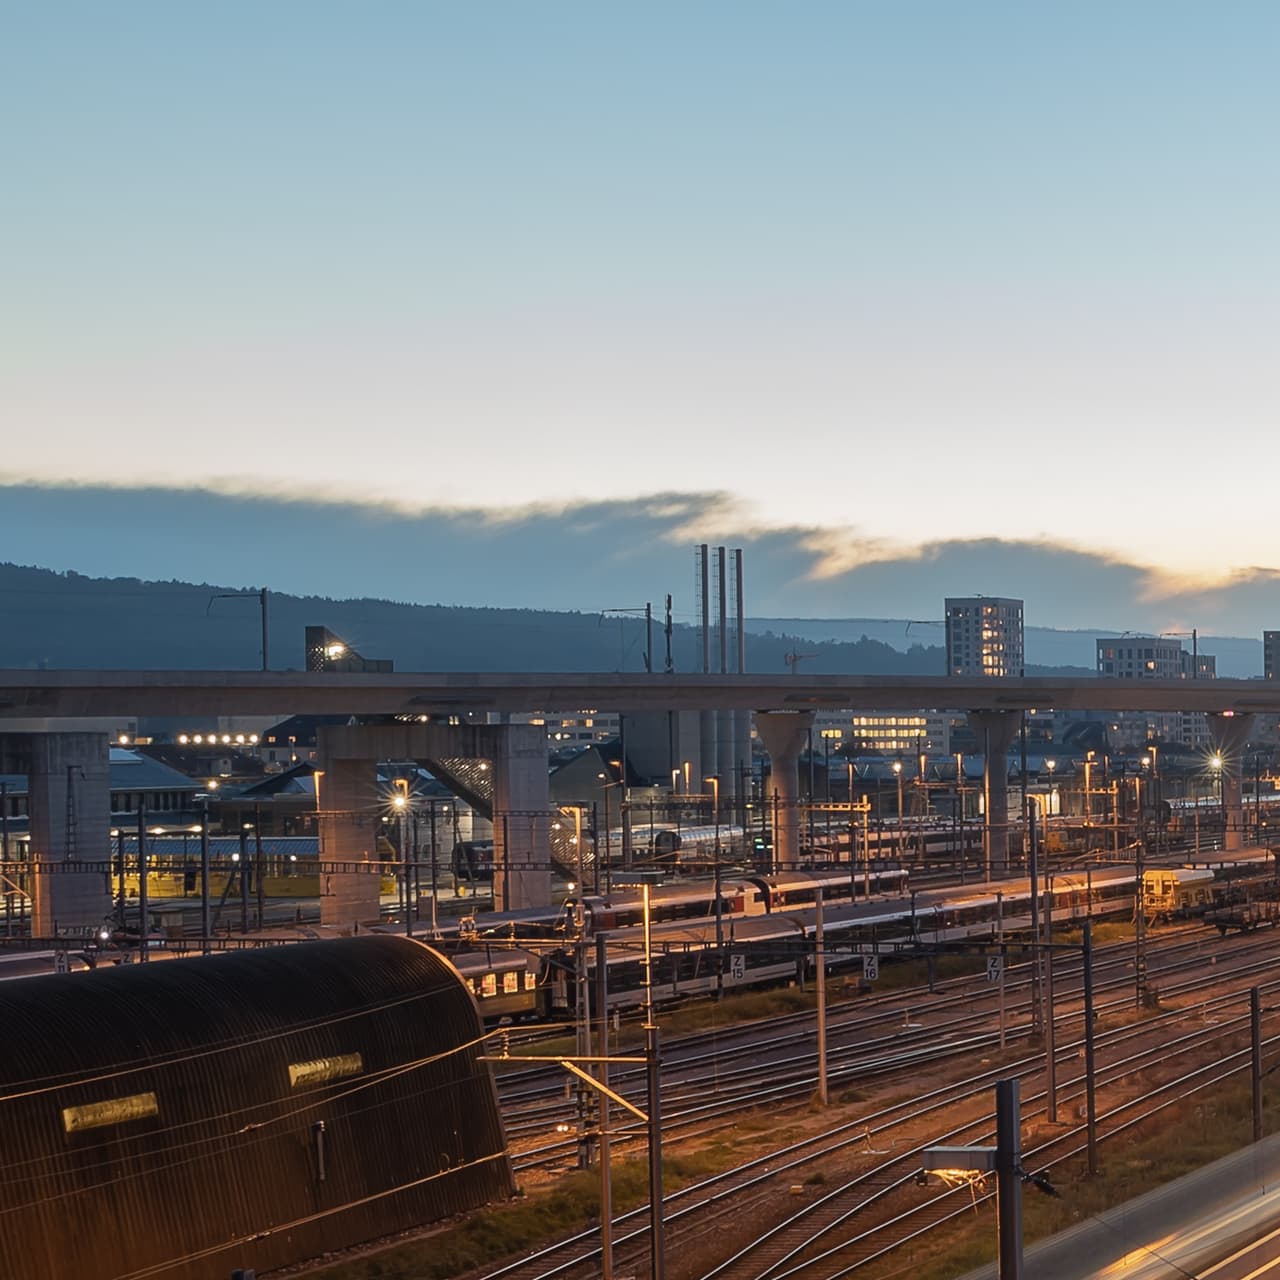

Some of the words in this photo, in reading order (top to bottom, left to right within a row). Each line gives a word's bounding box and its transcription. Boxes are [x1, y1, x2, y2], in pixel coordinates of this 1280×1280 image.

[733, 956, 742, 967] Z
[866, 956, 875, 967] Z
[990, 957, 998, 968] Z
[732, 968, 743, 979] 15
[865, 968, 876, 980] 16
[988, 969, 999, 980] 17
